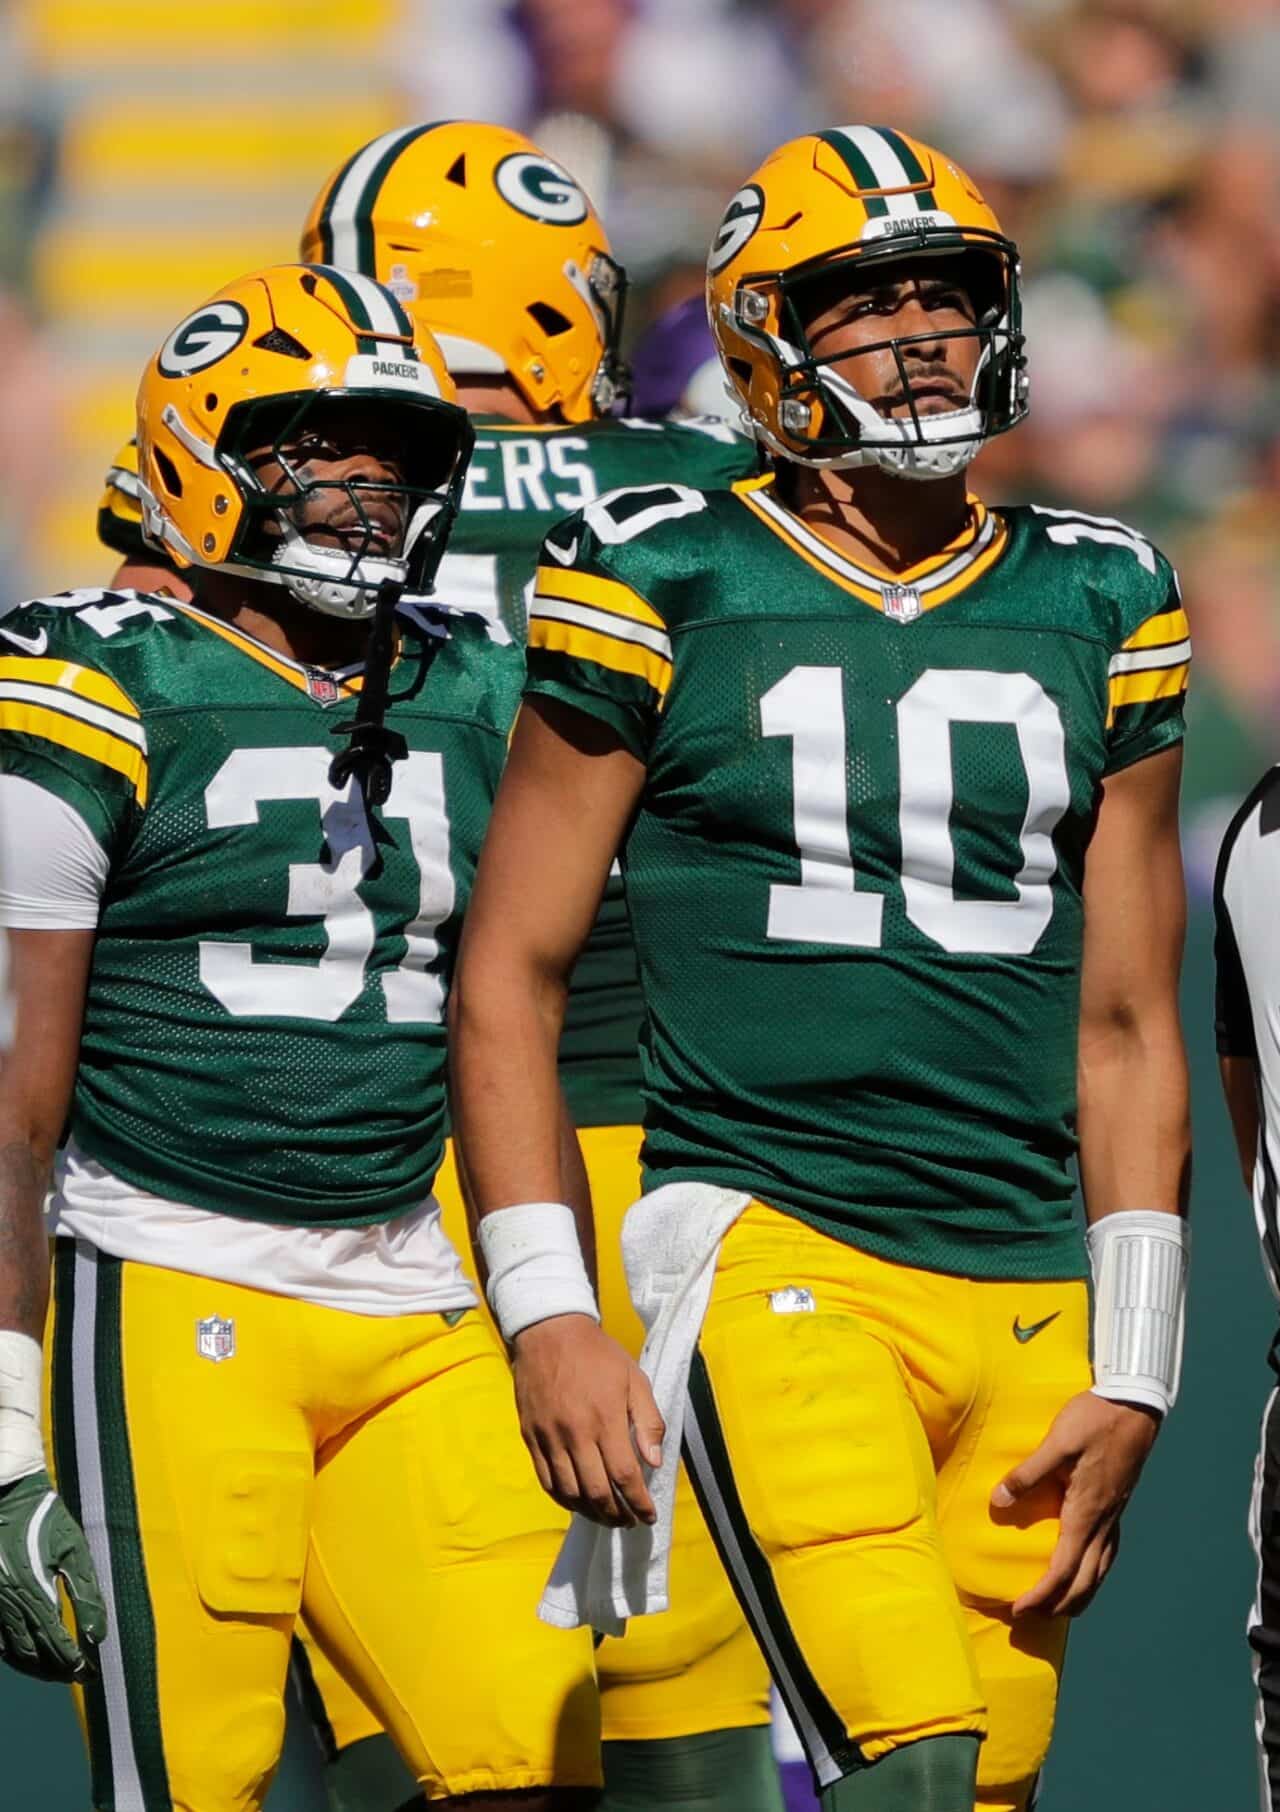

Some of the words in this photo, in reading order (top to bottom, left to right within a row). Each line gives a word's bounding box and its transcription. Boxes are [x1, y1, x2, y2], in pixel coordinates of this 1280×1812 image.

[493, 152, 589, 226] G
[883, 216, 937, 235] PACKERS
[158, 300, 250, 379] G
[372, 361, 419, 380] PACKERS
[760, 665, 1070, 955] 10
[199, 746, 455, 1023] 31
